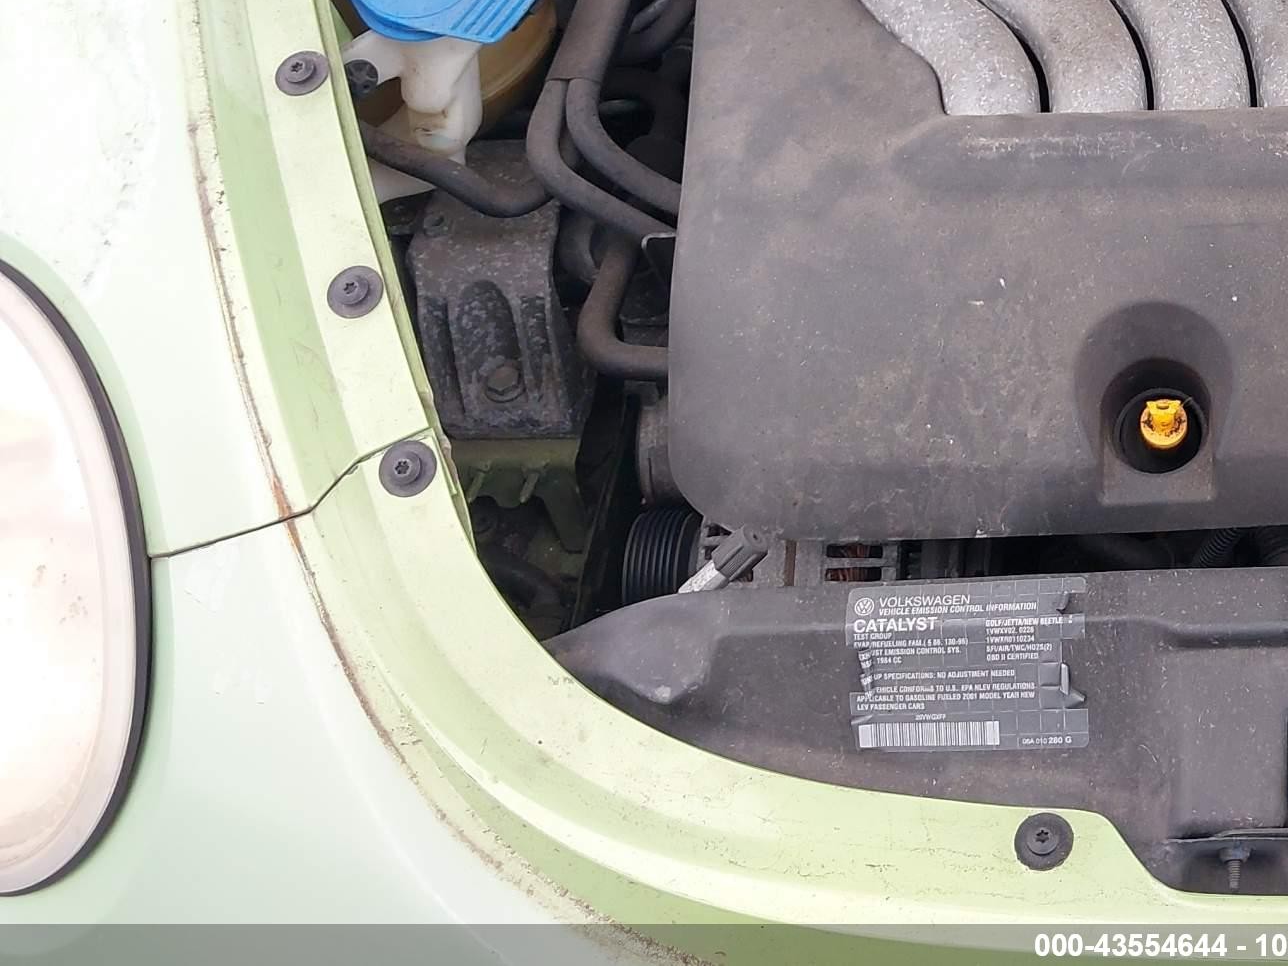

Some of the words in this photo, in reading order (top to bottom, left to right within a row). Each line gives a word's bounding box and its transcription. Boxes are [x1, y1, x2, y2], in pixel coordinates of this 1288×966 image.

[879, 594, 971, 608] VOLKSWAGEN
[879, 607, 910, 616] VEHICLE
[911, 605, 948, 614] EMISSION
[949, 604, 985, 613] CONTROL
[986, 602, 1037, 612] INFORMATION
[853, 616, 938, 633] CATALYST
[853, 633, 869, 641] TEST
[870, 632, 893, 640] GROUP
[916, 647, 946, 655] CONTROL
[893, 656, 902, 664] CC
[1006, 652, 1039, 661] CERTIFIED
[937, 671, 946, 679] NO
[947, 670, 990, 679] ADJUSTMENT
[991, 669, 1015, 677] NEEDED
[876, 685, 898, 694] EHICLE
[935, 684, 944, 692] TO
[992, 682, 1035, 690] REGULATIONS
[895, 694, 904, 702] TO
[905, 693, 936, 701] GASOLINE
[937, 693, 961, 701] FUELED
[979, 691, 1002, 700] MODEL
[1002, 691, 1019, 699] YEAR
[1020, 690, 1035, 698] NEW
[870, 702, 907, 711] PASSENGER
[907, 702, 925, 710] CARS
